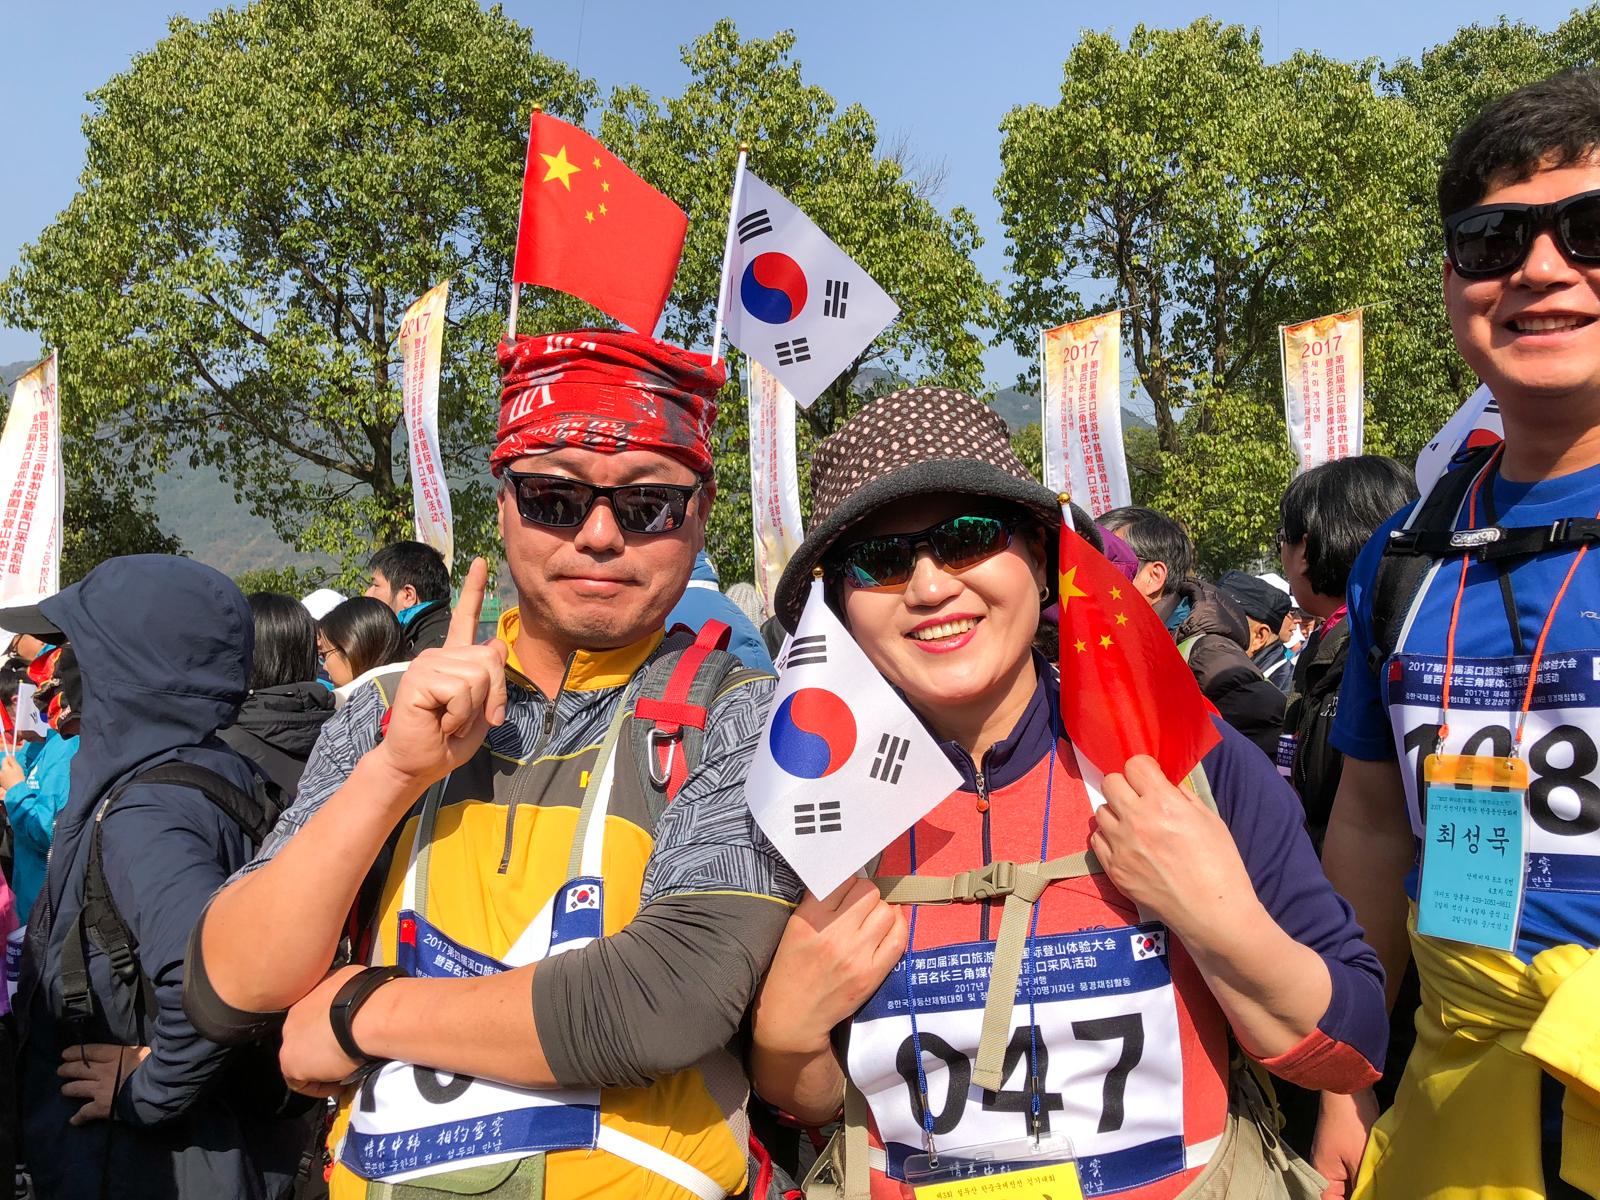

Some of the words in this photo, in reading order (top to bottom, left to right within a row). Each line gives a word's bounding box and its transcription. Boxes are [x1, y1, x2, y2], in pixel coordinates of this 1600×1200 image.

[1063, 340, 1099, 364] 2017
[1301, 335, 1342, 359] 2017
[1436, 822, 1510, 858] 최성묵
[955, 981, 984, 993] 2017년
[967, 993, 976, 1002] 및
[896, 1012, 1145, 1137] 047
[482, 1139, 504, 1155] 만남
